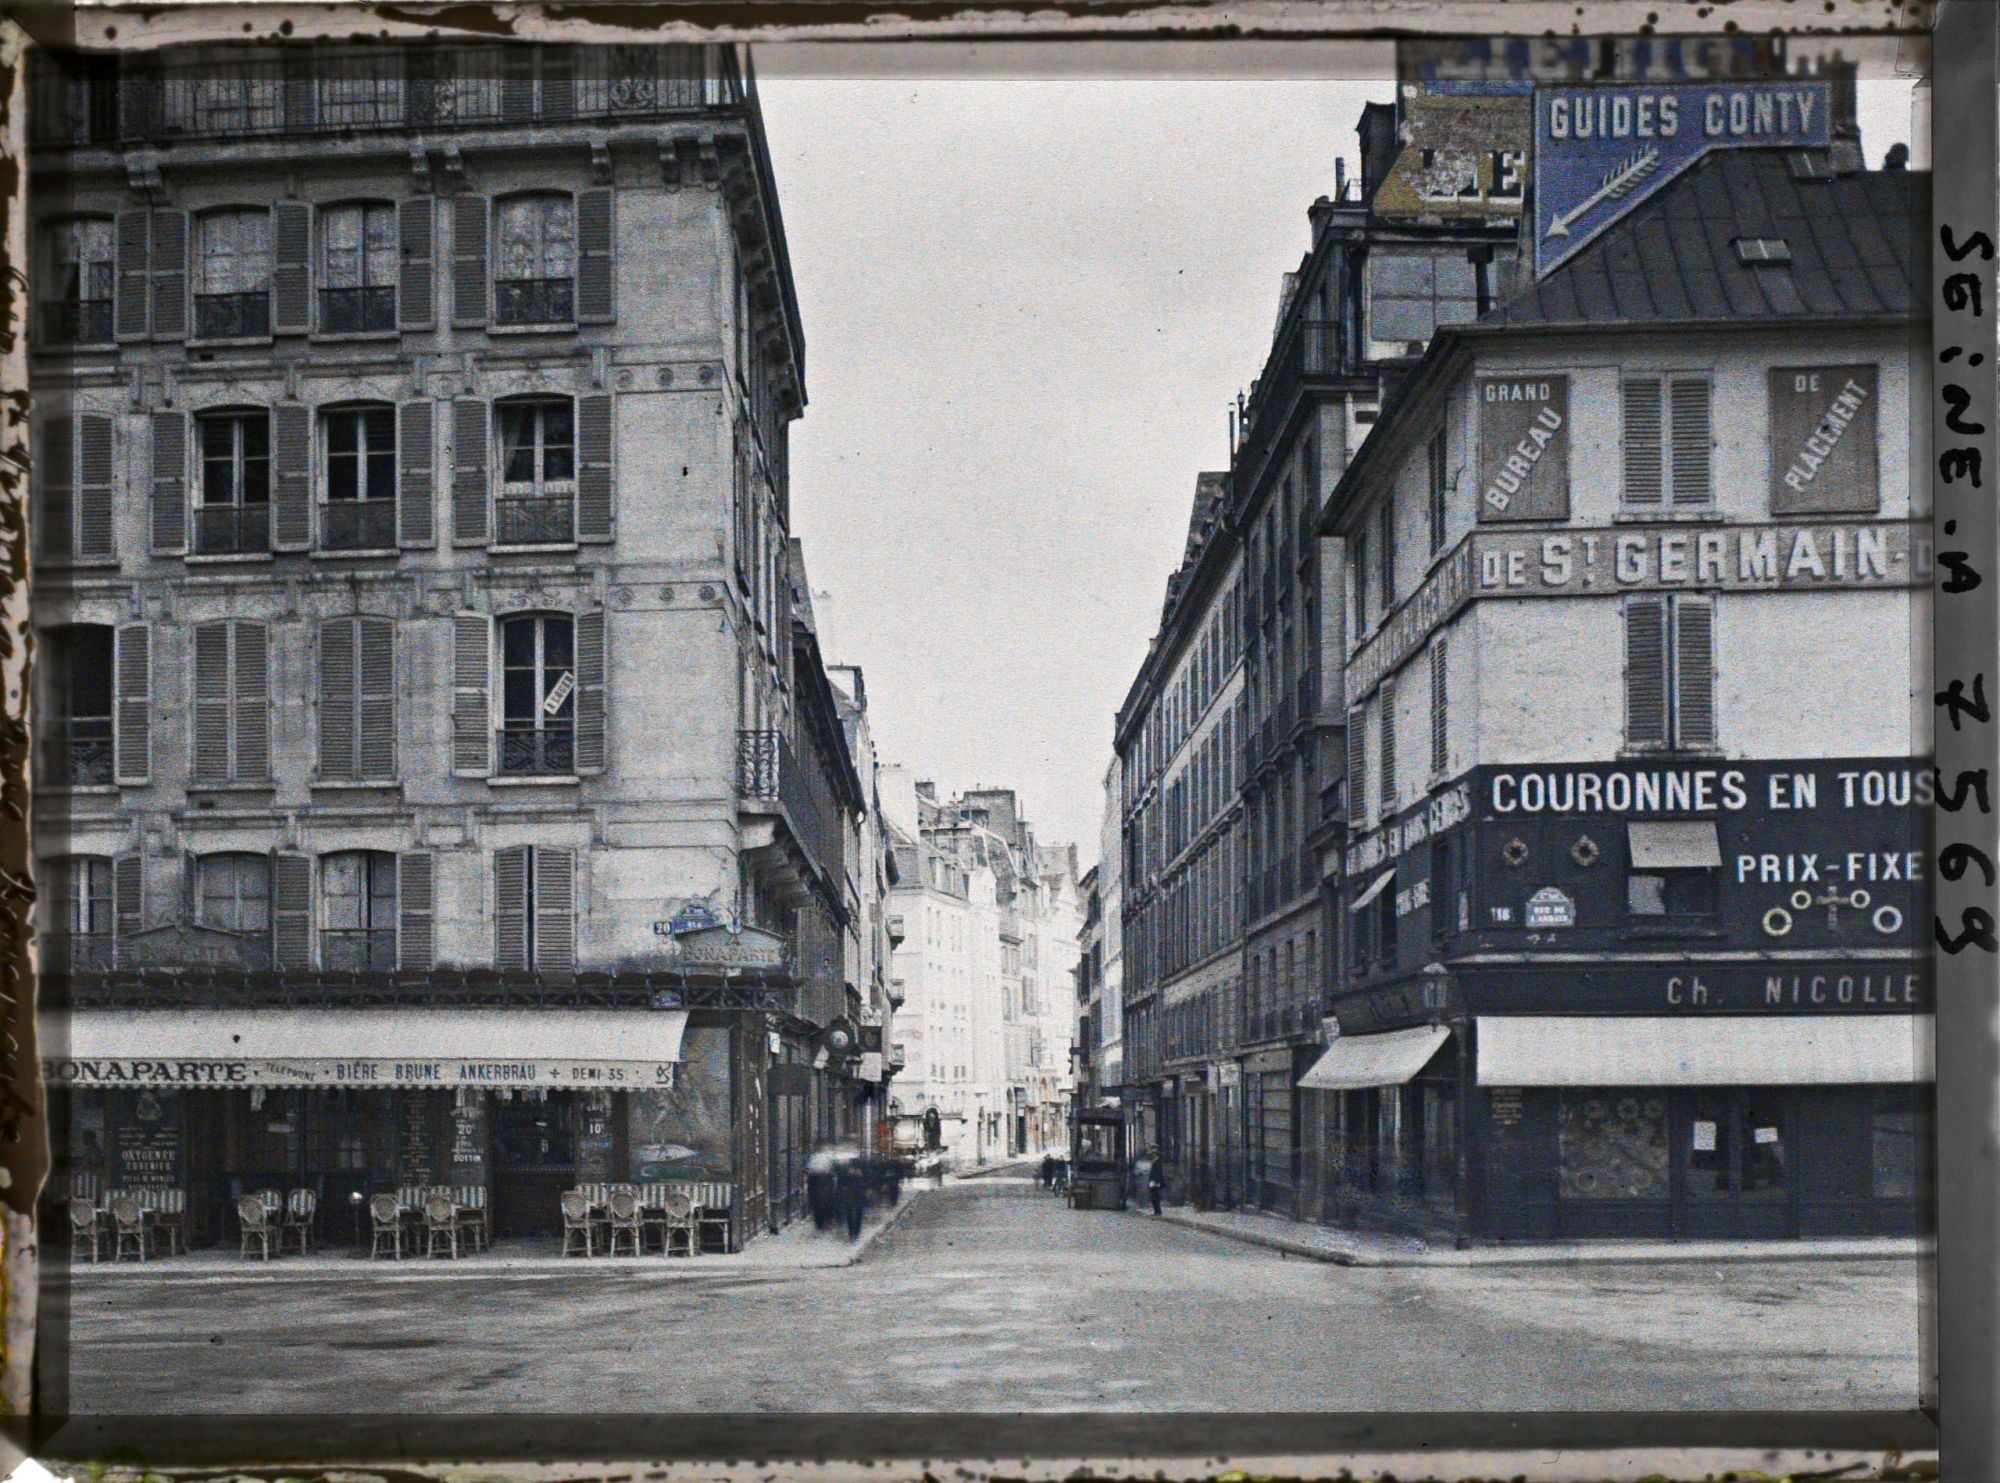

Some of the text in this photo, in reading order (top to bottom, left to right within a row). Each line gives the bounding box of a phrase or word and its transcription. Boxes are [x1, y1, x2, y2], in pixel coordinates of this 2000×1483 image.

[1551, 92, 1814, 138] GUIDES CONTY
[1486, 384, 1550, 402] GRAND
[1794, 374, 1820, 393] DE
[1784, 378, 1868, 493] PLACEMENT
[1484, 406, 1562, 511] BUREAU
[1481, 550, 1526, 587] DE
[1492, 770, 1934, 813] COURONNES EN TOUS
[1737, 852, 1924, 883] PRIX-FIXE
[1766, 974, 1920, 1004] NICOLLE
[395, 1064, 441, 1080] BRUNE
[572, 1068, 600, 1080] DEMI
